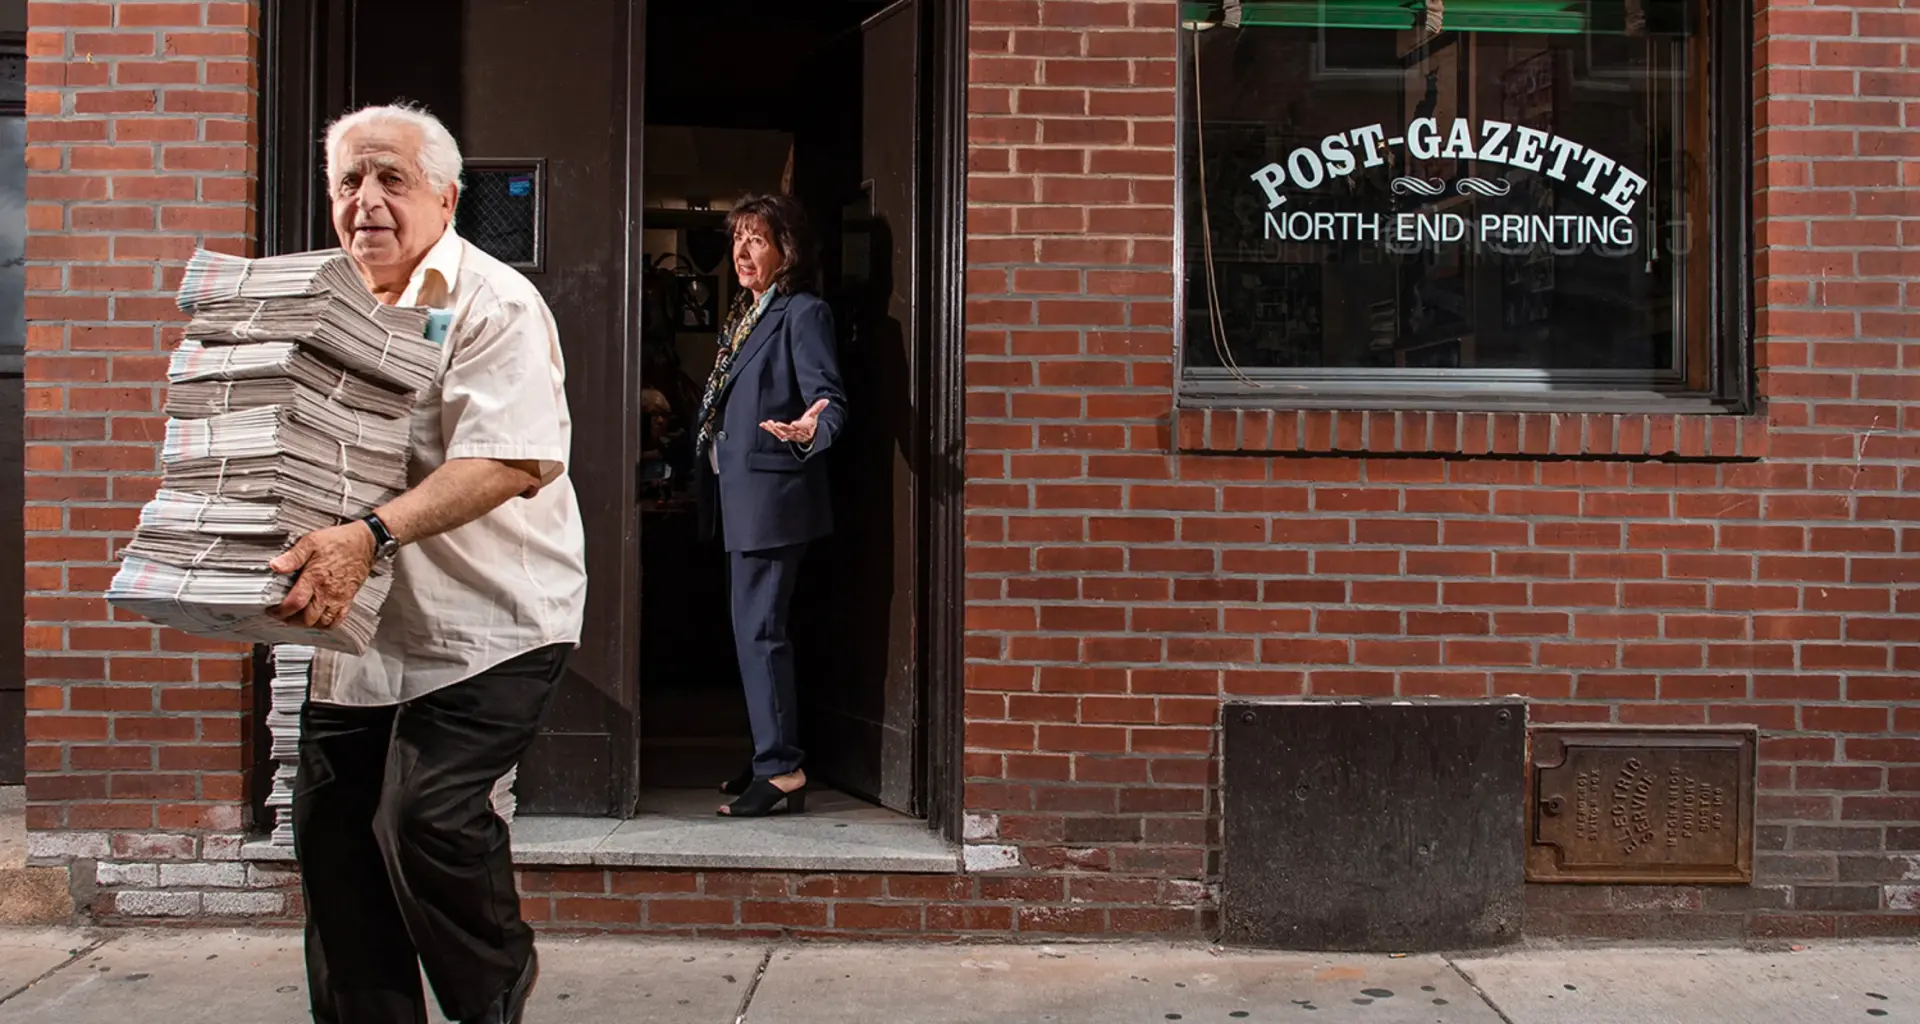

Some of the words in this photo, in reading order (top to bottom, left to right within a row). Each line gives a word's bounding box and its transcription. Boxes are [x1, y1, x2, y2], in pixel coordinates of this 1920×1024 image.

[1250, 117, 1648, 215] POST-GAZETTE
[1264, 211, 1380, 241] NORTH
[1397, 213, 1464, 242] END
[1481, 214, 1633, 245] PRINTING
[1611, 757, 1641, 854] ELECTRIC
[1631, 773, 1657, 844] SERVICE
